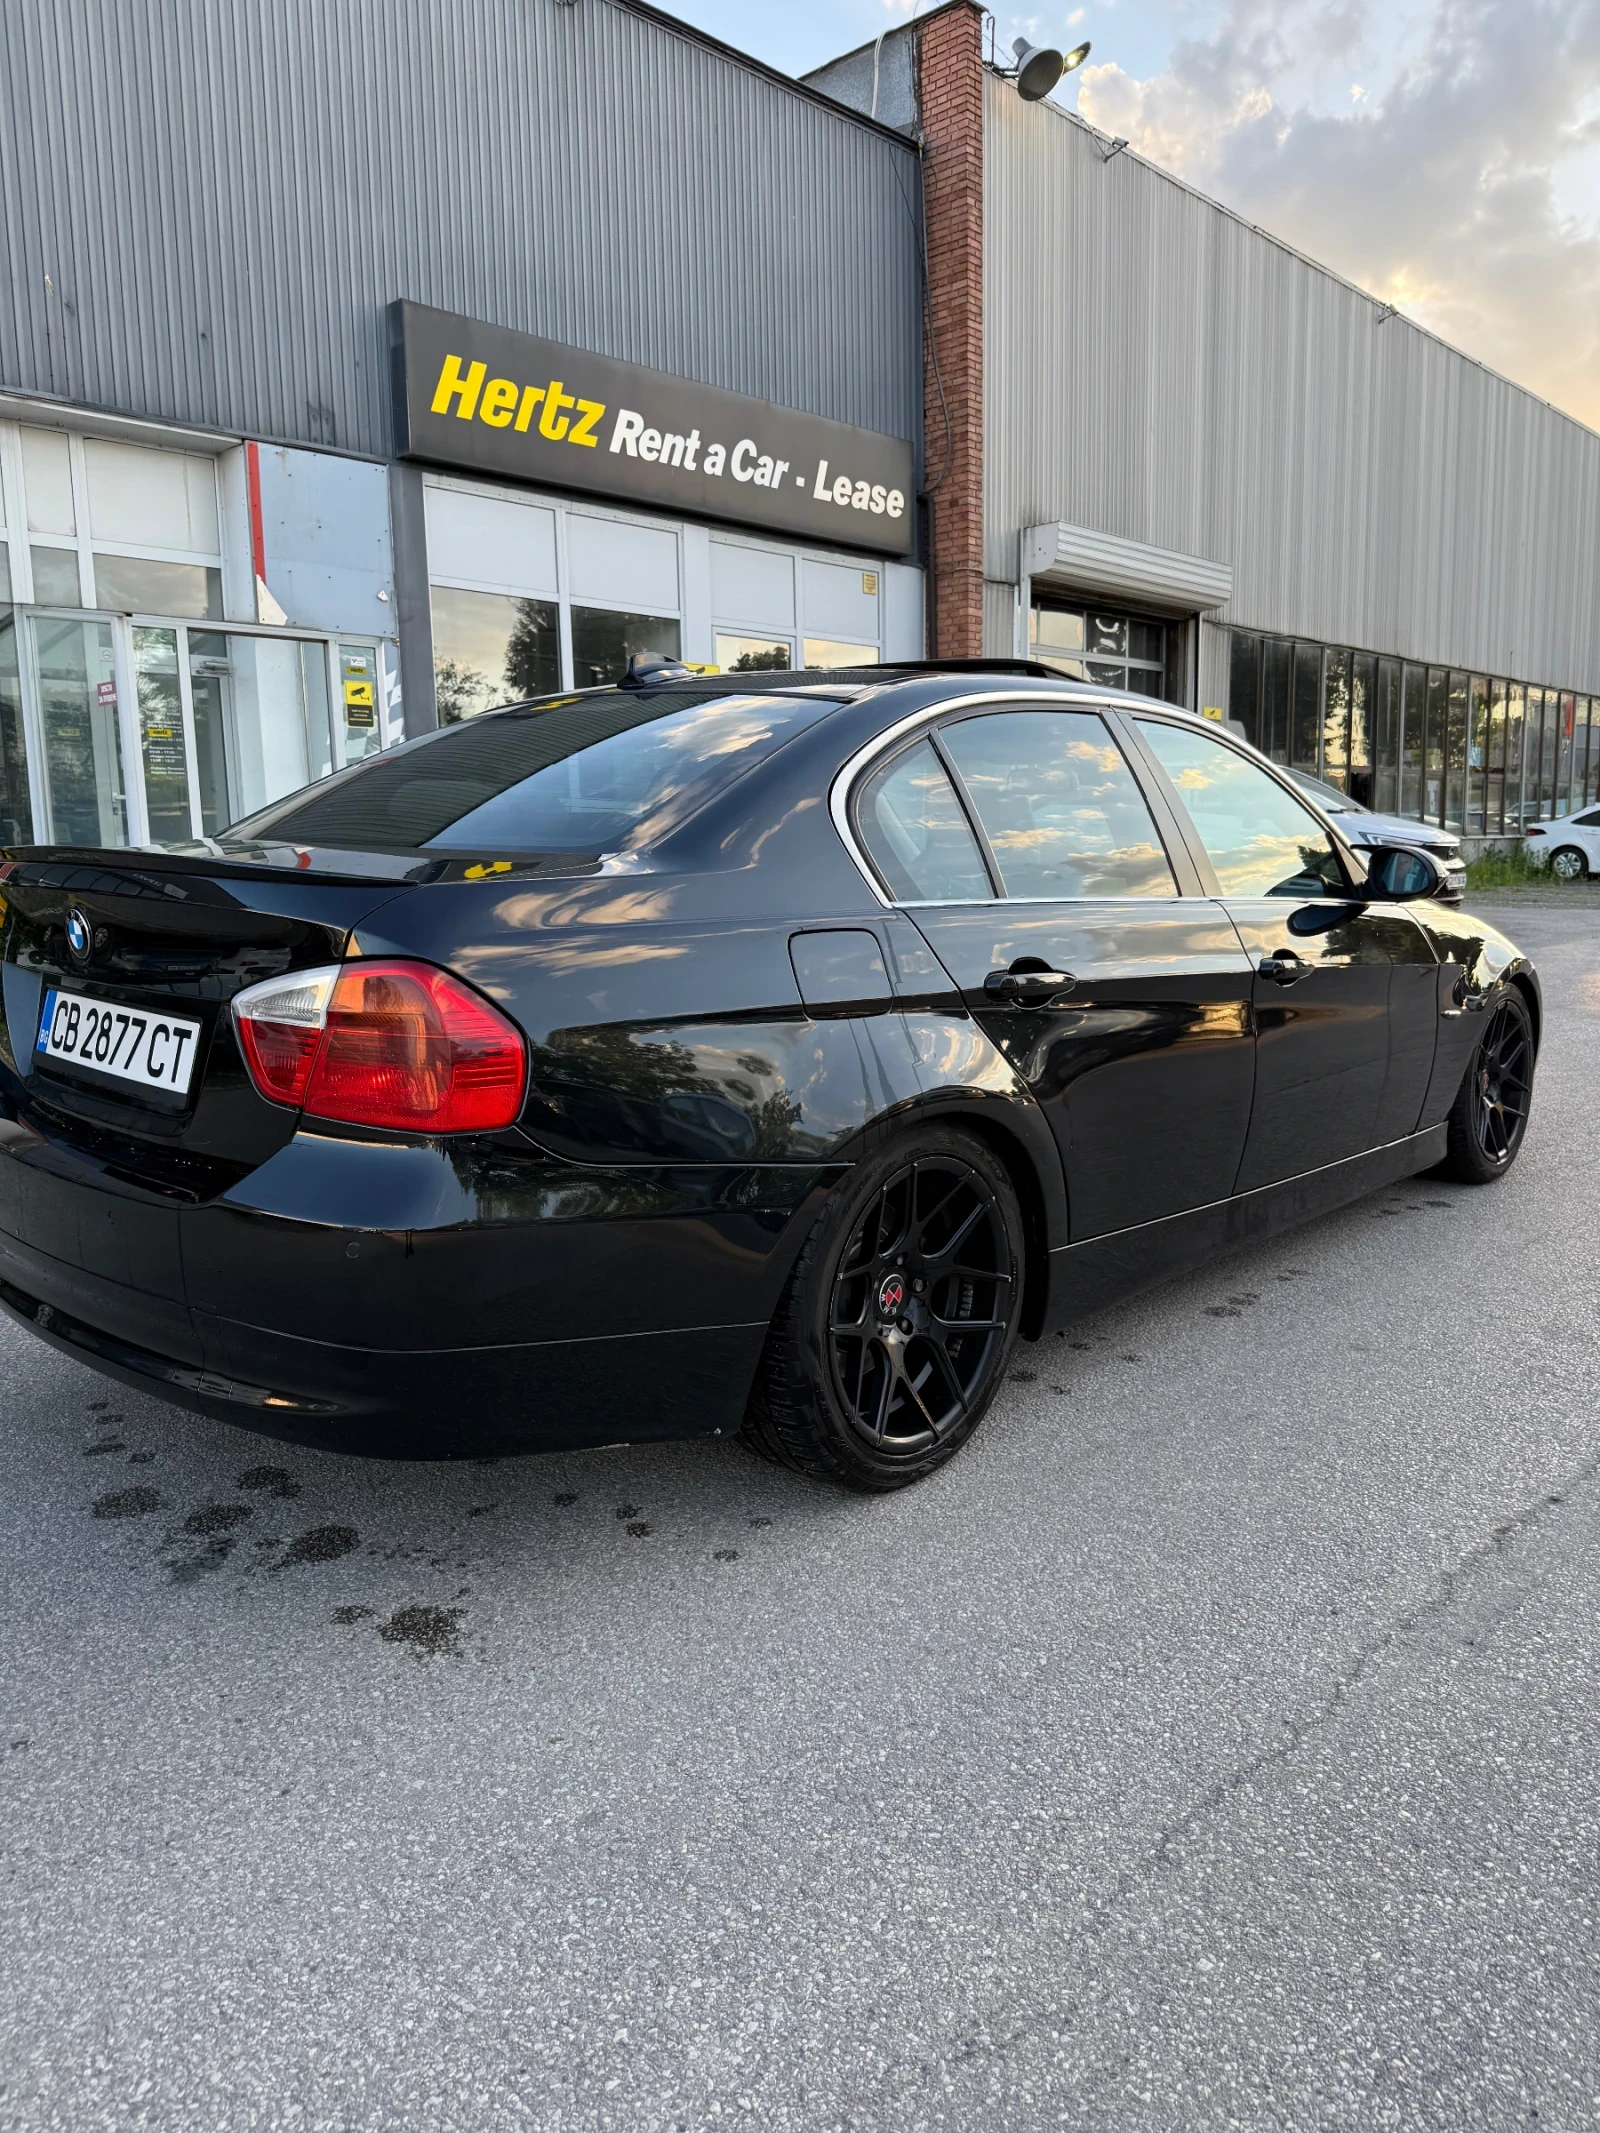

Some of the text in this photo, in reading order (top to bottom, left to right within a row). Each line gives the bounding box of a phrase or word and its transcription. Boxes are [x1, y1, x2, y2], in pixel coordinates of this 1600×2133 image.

[430, 353, 606, 448] Hertz
[609, 408, 701, 472] Rent
[703, 442, 726, 477] a
[730, 438, 790, 490] Car
[812, 459, 905, 519] Lease
[39, 1028, 49, 1044] BG
[51, 1000, 192, 1083] CB 2877 CT
